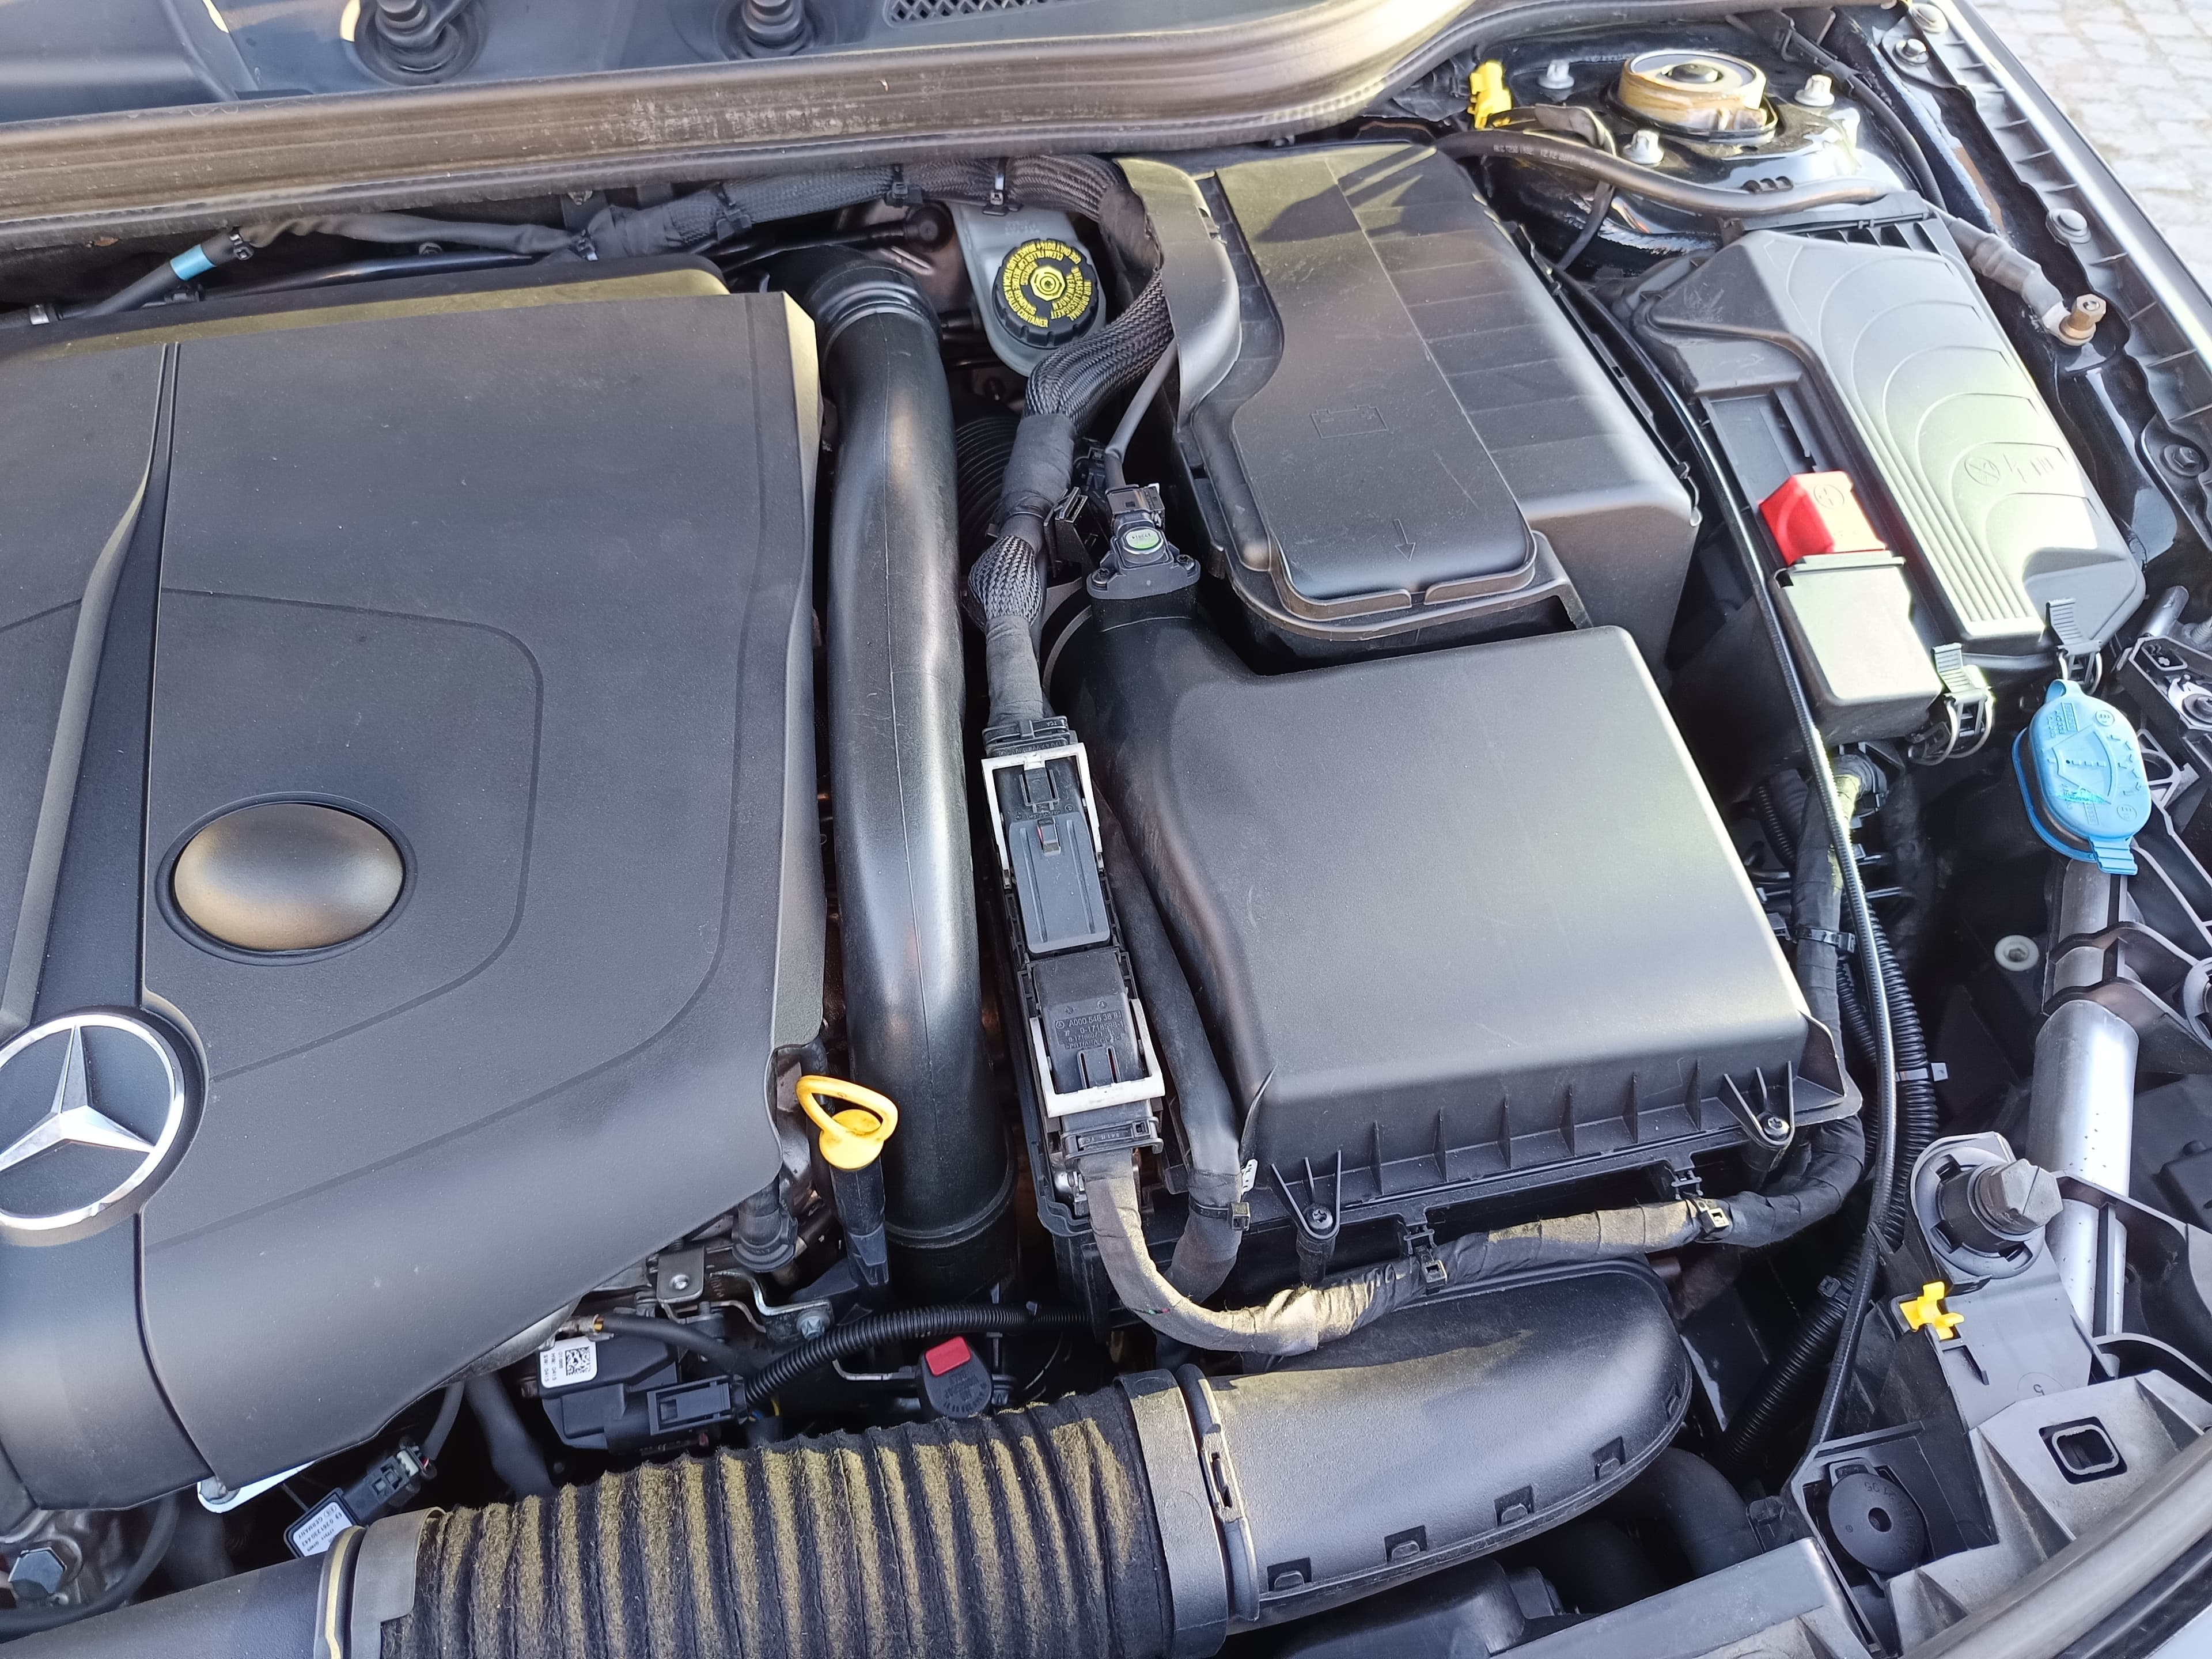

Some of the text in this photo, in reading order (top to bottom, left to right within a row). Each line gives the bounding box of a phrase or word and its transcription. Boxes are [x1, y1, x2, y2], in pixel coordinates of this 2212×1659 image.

[1018, 243, 1036, 258] BRAKE
[1007, 254, 1021, 270] FLUID
[1003, 269, 1012, 286] FROM
[1012, 249, 1064, 315] CLEAN FILLER CAP BEFORE REMOVING
[1005, 290, 1020, 312] SEALED
[1052, 273, 1075, 310] VERWENDEN
[1017, 309, 1048, 328] CONTAINER
[1067, 296, 1090, 321] ORIGINAL
[298, 1516, 323, 1540] GERMANY
